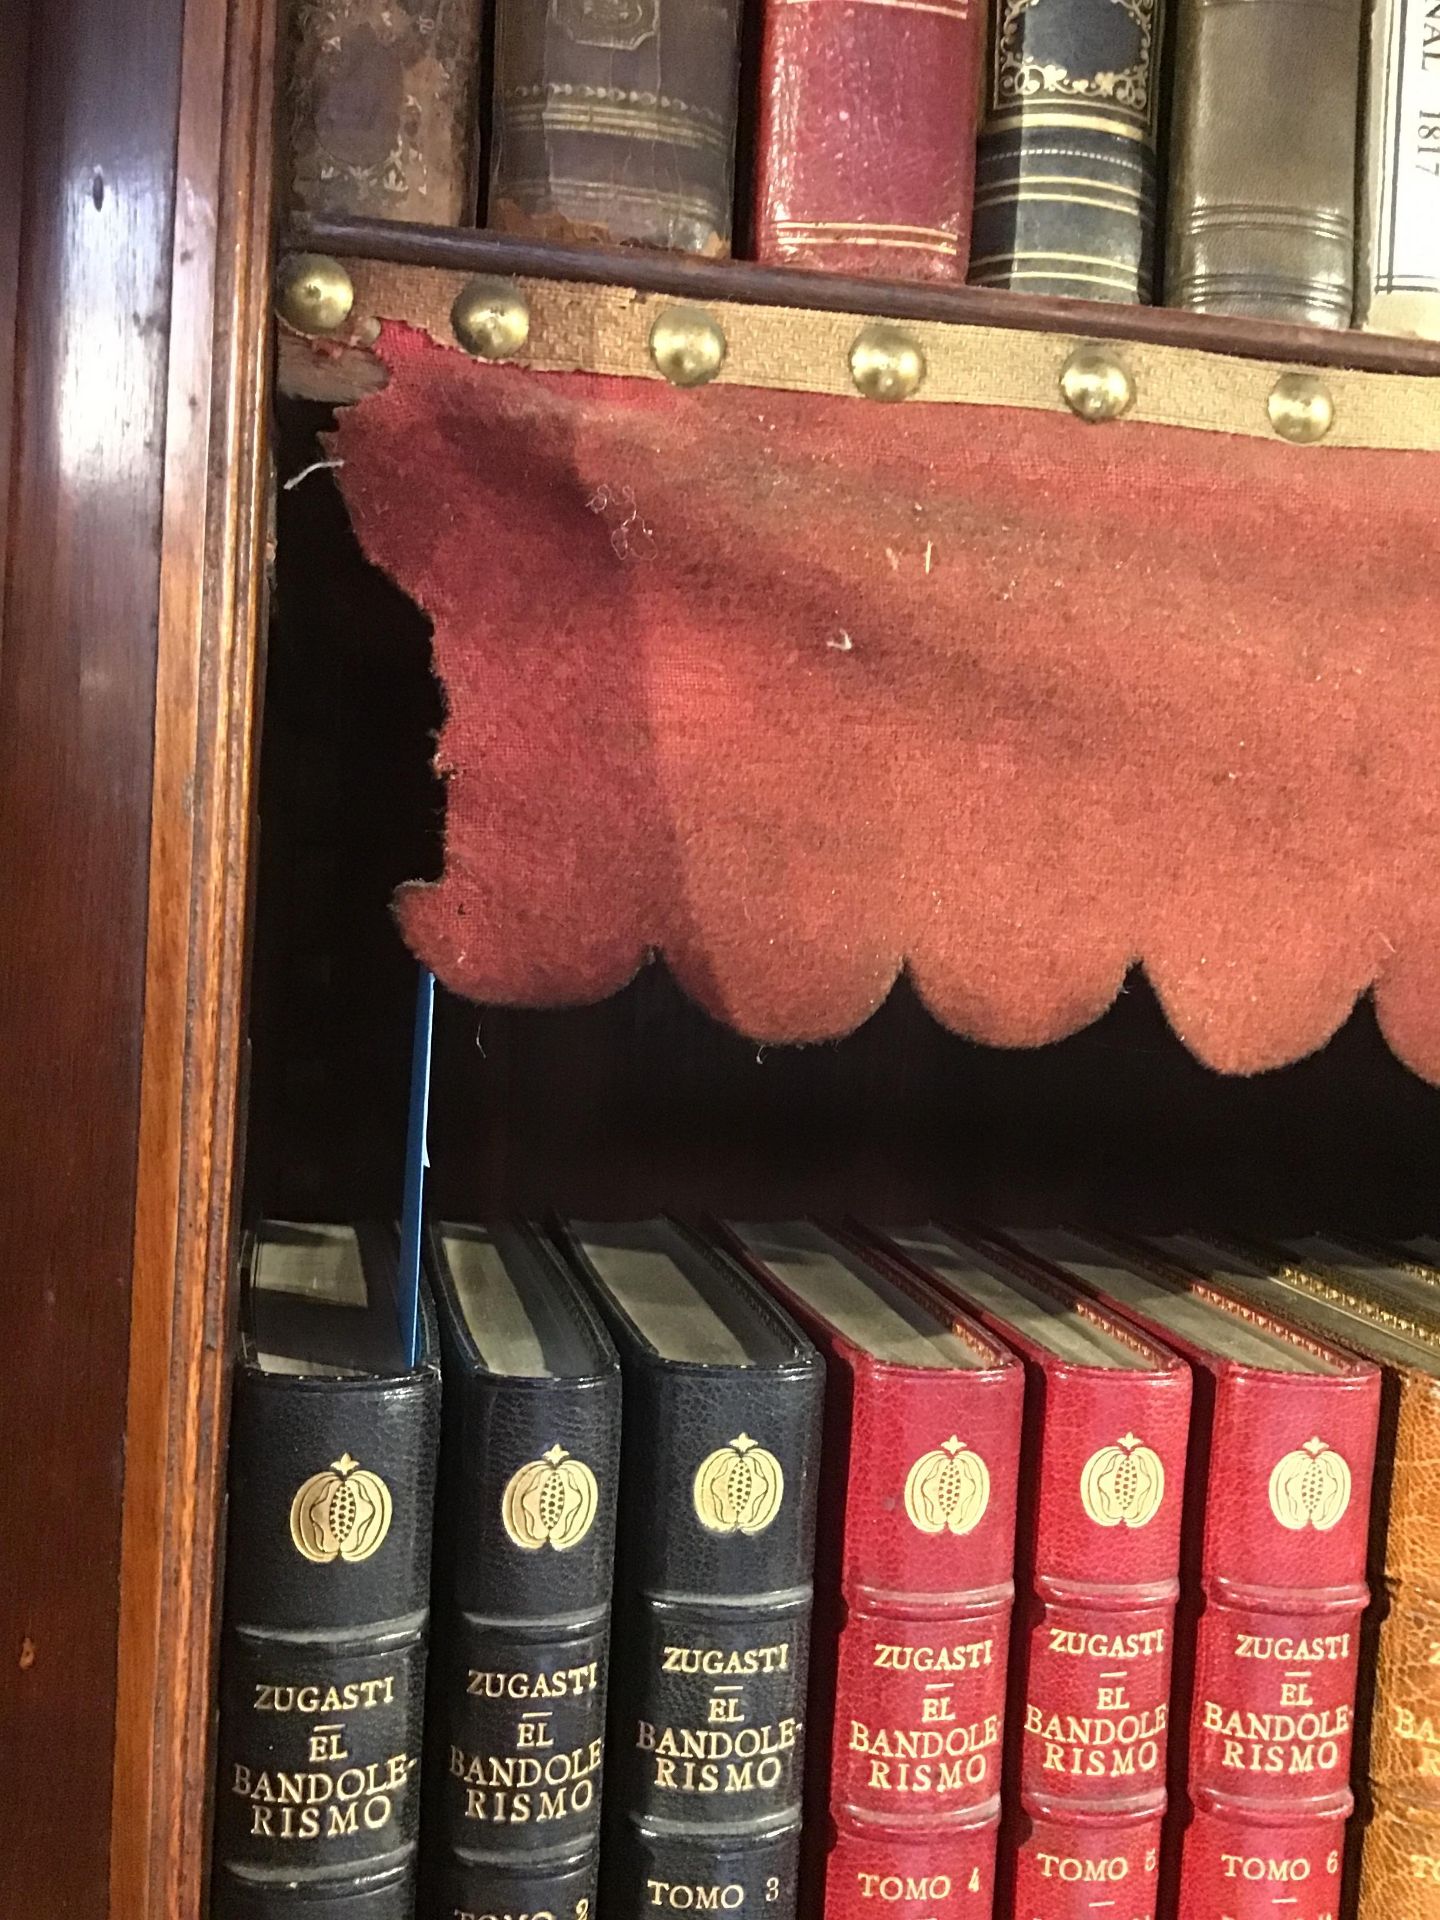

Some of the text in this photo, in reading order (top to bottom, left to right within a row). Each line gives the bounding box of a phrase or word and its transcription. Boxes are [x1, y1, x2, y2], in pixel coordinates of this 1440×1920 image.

[1415, 109, 1440, 177] 1817
[662, 1644, 789, 1674] ZUGASTI
[874, 1640, 993, 1671] ZUGASTI
[1049, 1628, 1164, 1658] ZUGASTI
[1235, 1633, 1350, 1660] ZUGASTI
[254, 1676, 394, 1712] ZUGASTI
[467, 1662, 597, 1698] ZUGASTI
[1280, 1683, 1313, 1706] EL
[708, 1698, 744, 1722] EL
[921, 1696, 956, 1723] EL
[1096, 1687, 1130, 1710] EL
[309, 1734, 348, 1762] EL
[517, 1722, 554, 1749] EL
[868, 1753, 986, 1792] RISMO
[1043, 1740, 1158, 1776] RISMO
[1222, 1739, 1338, 1774] RISMO
[654, 1757, 781, 1792] RISMO
[250, 1795, 391, 1838] RISMO
[465, 1779, 593, 1823] RISMO
[1037, 1847, 1156, 1881] TOMO 5
[1221, 1850, 1338, 1881] TOMO 6
[647, 1877, 779, 1909] TOMO 3
[858, 1867, 980, 1901] TOMO 4
